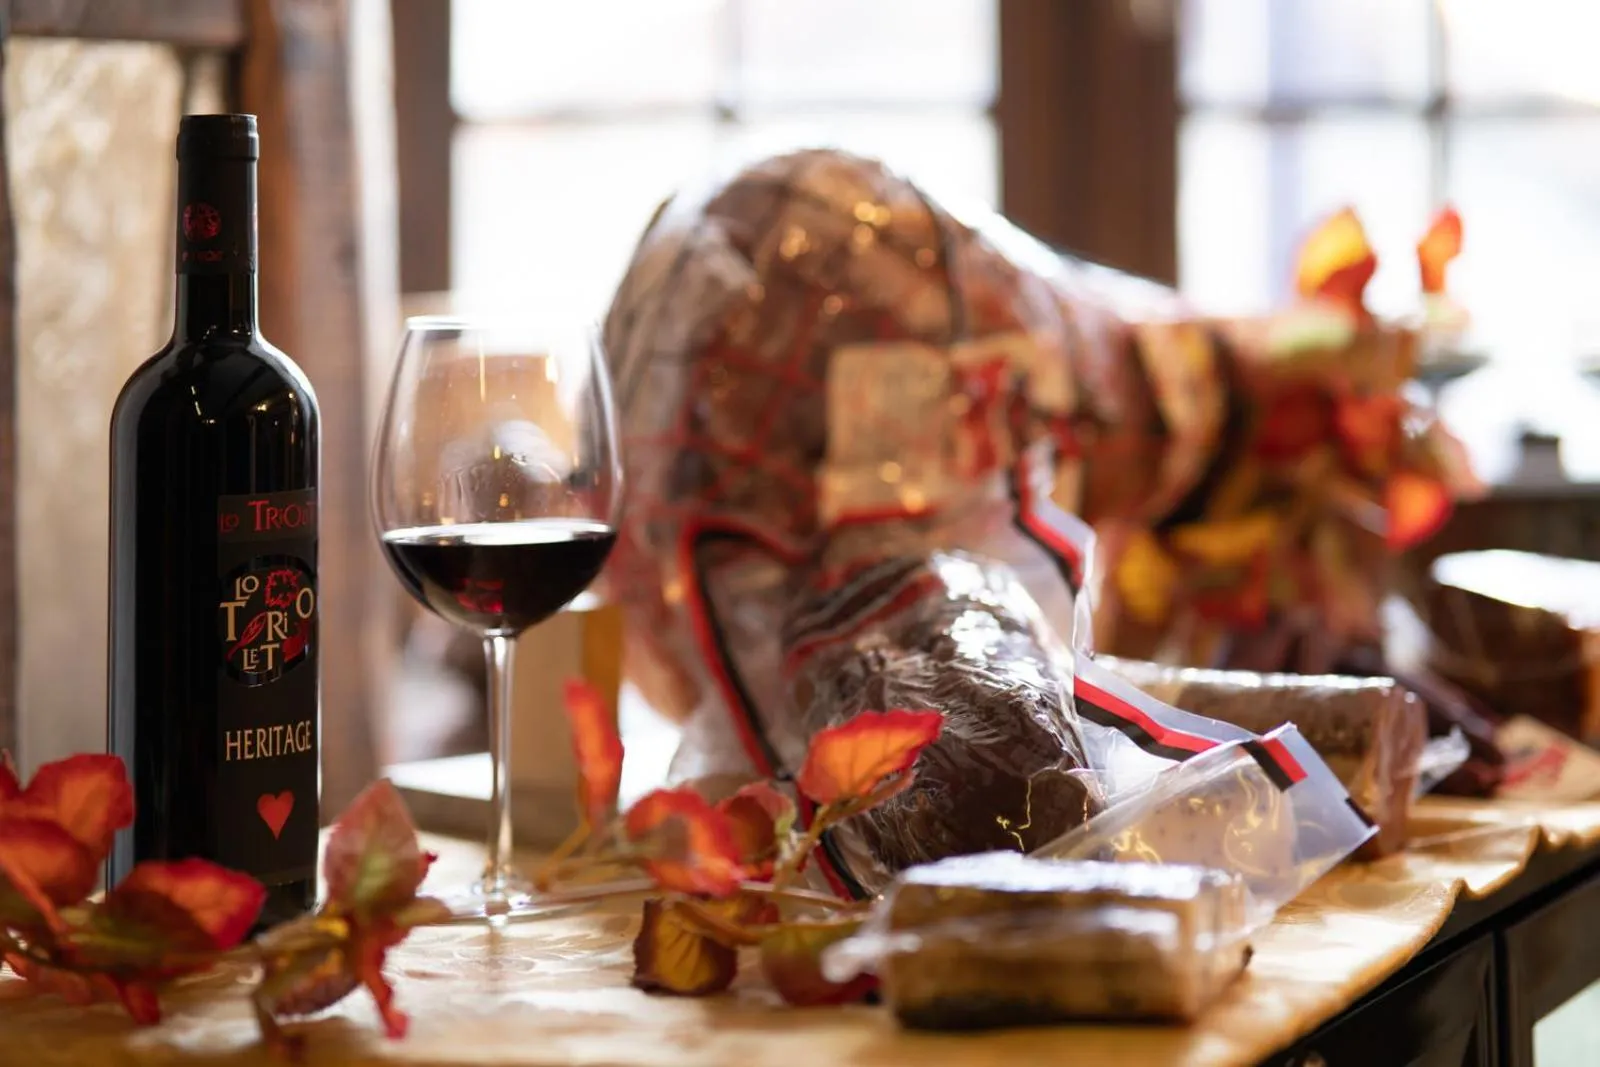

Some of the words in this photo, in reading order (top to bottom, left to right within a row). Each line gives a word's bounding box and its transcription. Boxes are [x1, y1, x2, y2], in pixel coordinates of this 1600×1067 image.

[235, 574, 260, 600] LO
[241, 642, 281, 671] LET
[225, 720, 312, 761] HERITAGE
